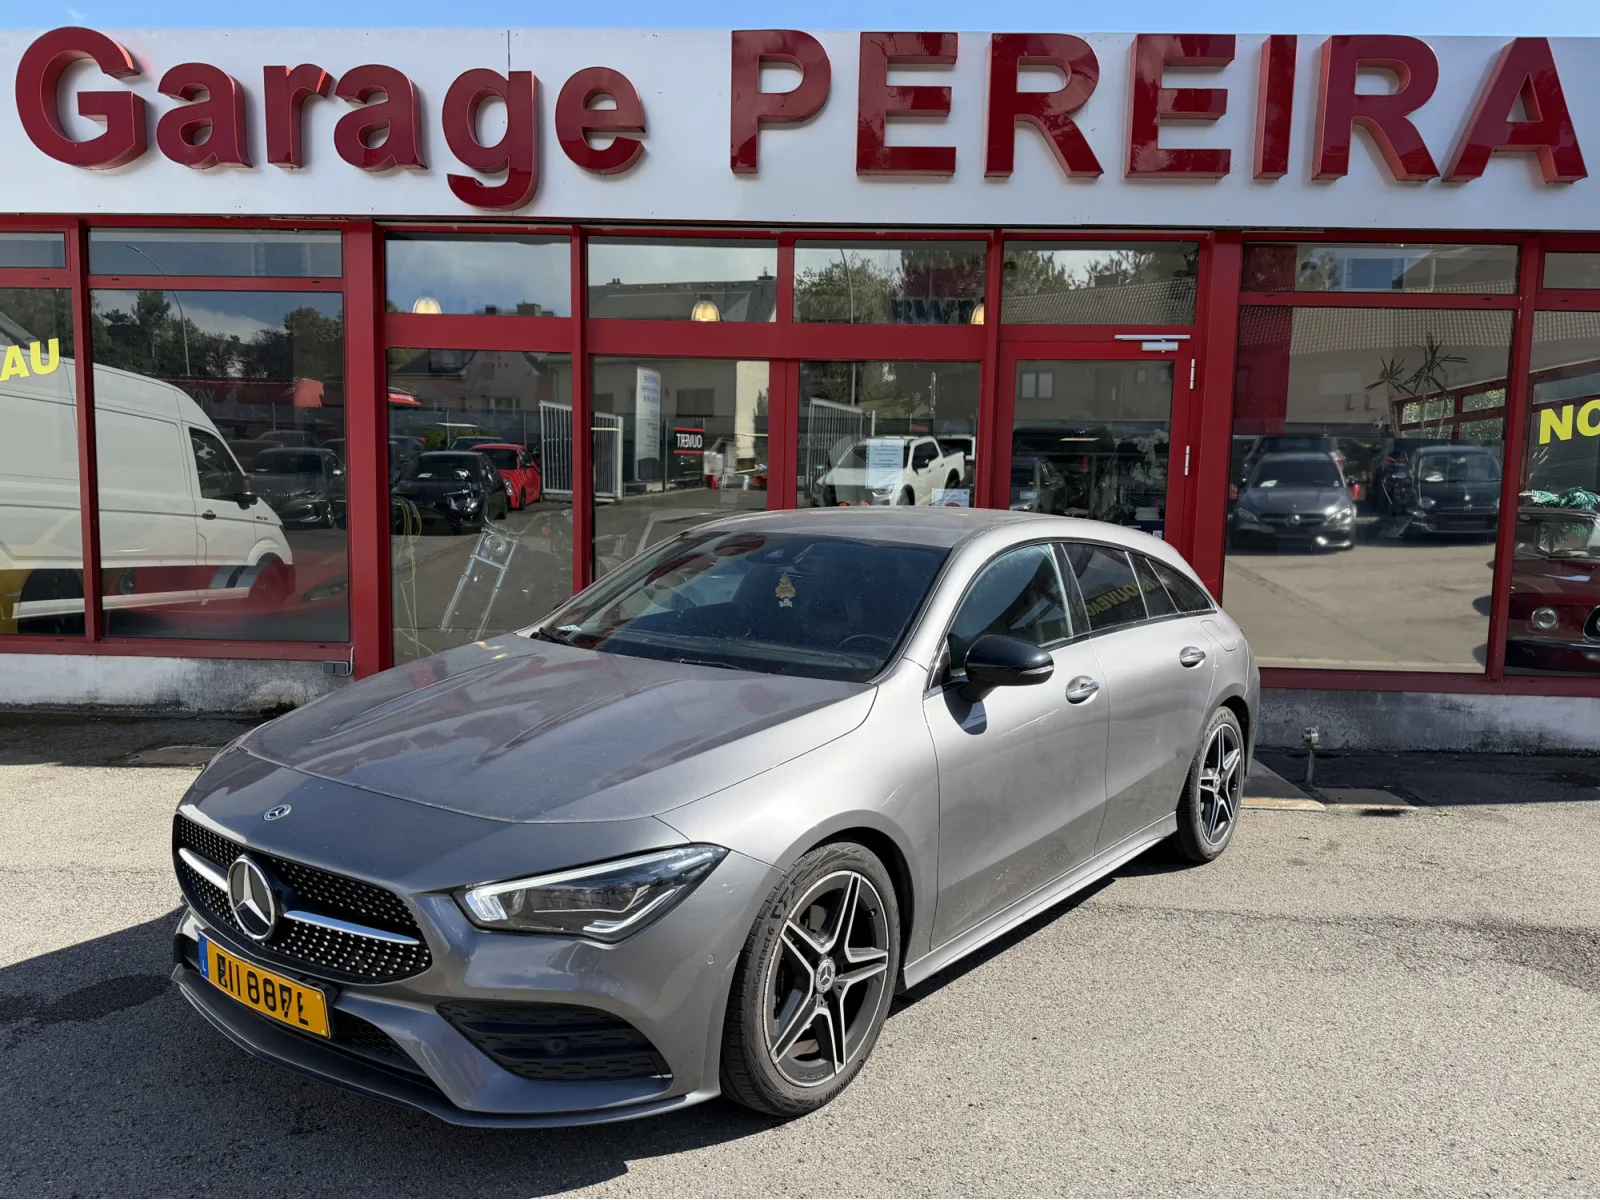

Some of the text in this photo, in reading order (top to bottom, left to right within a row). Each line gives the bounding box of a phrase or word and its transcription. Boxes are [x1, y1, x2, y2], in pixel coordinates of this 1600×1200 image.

[15, 26, 1587, 210] Garage PEREIRA
[0, 338, 59, 382] AU
